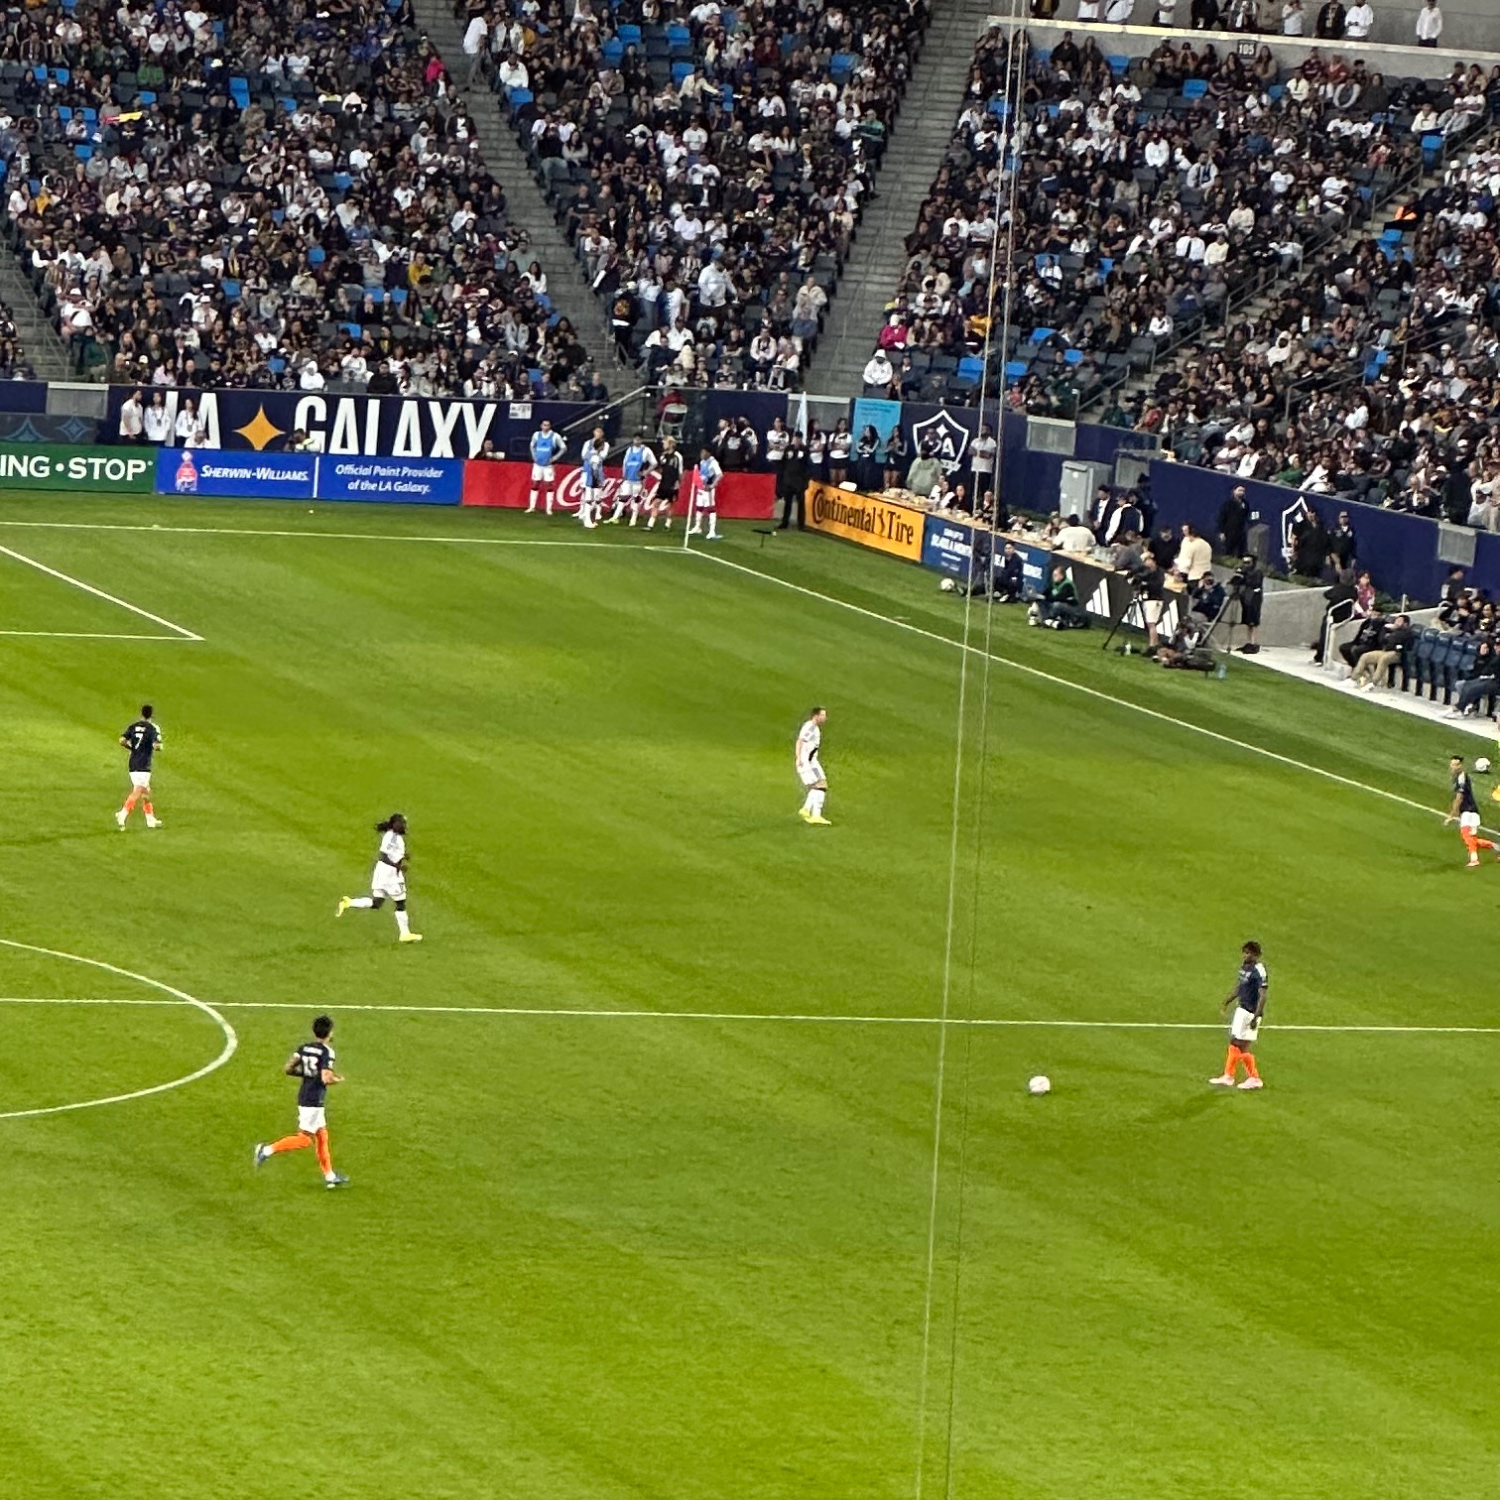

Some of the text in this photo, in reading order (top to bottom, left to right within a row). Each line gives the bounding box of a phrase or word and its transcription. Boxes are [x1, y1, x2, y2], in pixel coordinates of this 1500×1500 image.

[1239, 43, 1255, 55] 105
[293, 395, 498, 459] GALAXY
[335, 464, 444, 478] Official Paint Provider
[348, 480, 360, 491] of
[361, 480, 378, 491] the
[378, 481, 392, 491] LA
[812, 487, 914, 546] Continental Tire
[134, 732, 144, 750] 7
